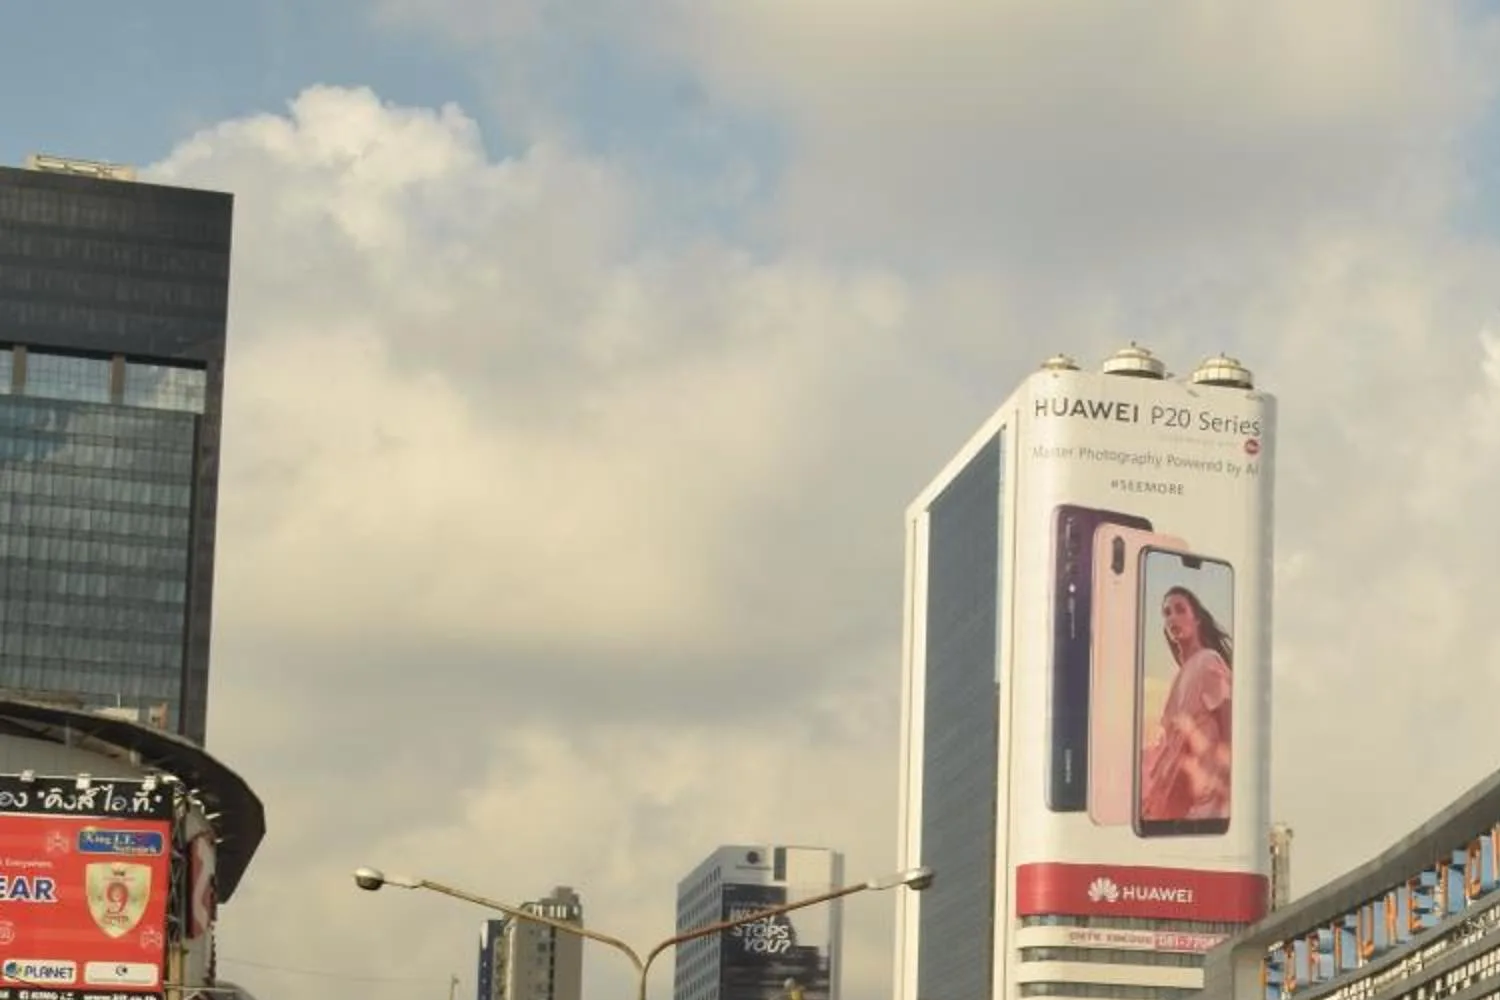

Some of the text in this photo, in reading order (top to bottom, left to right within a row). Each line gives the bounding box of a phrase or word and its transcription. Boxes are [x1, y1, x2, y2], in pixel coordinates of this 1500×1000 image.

[1035, 398, 1261, 437] HUAWEI P20 Series
[1033, 445, 1259, 477] Master Photography Powered by AI
[1111, 479, 1184, 496] #SEEMORE
[1123, 886, 1193, 903] HUAWEI
[734, 924, 789, 939] STOPS
[744, 937, 791, 954] YOU?
[23, 964, 74, 979] PLANET
